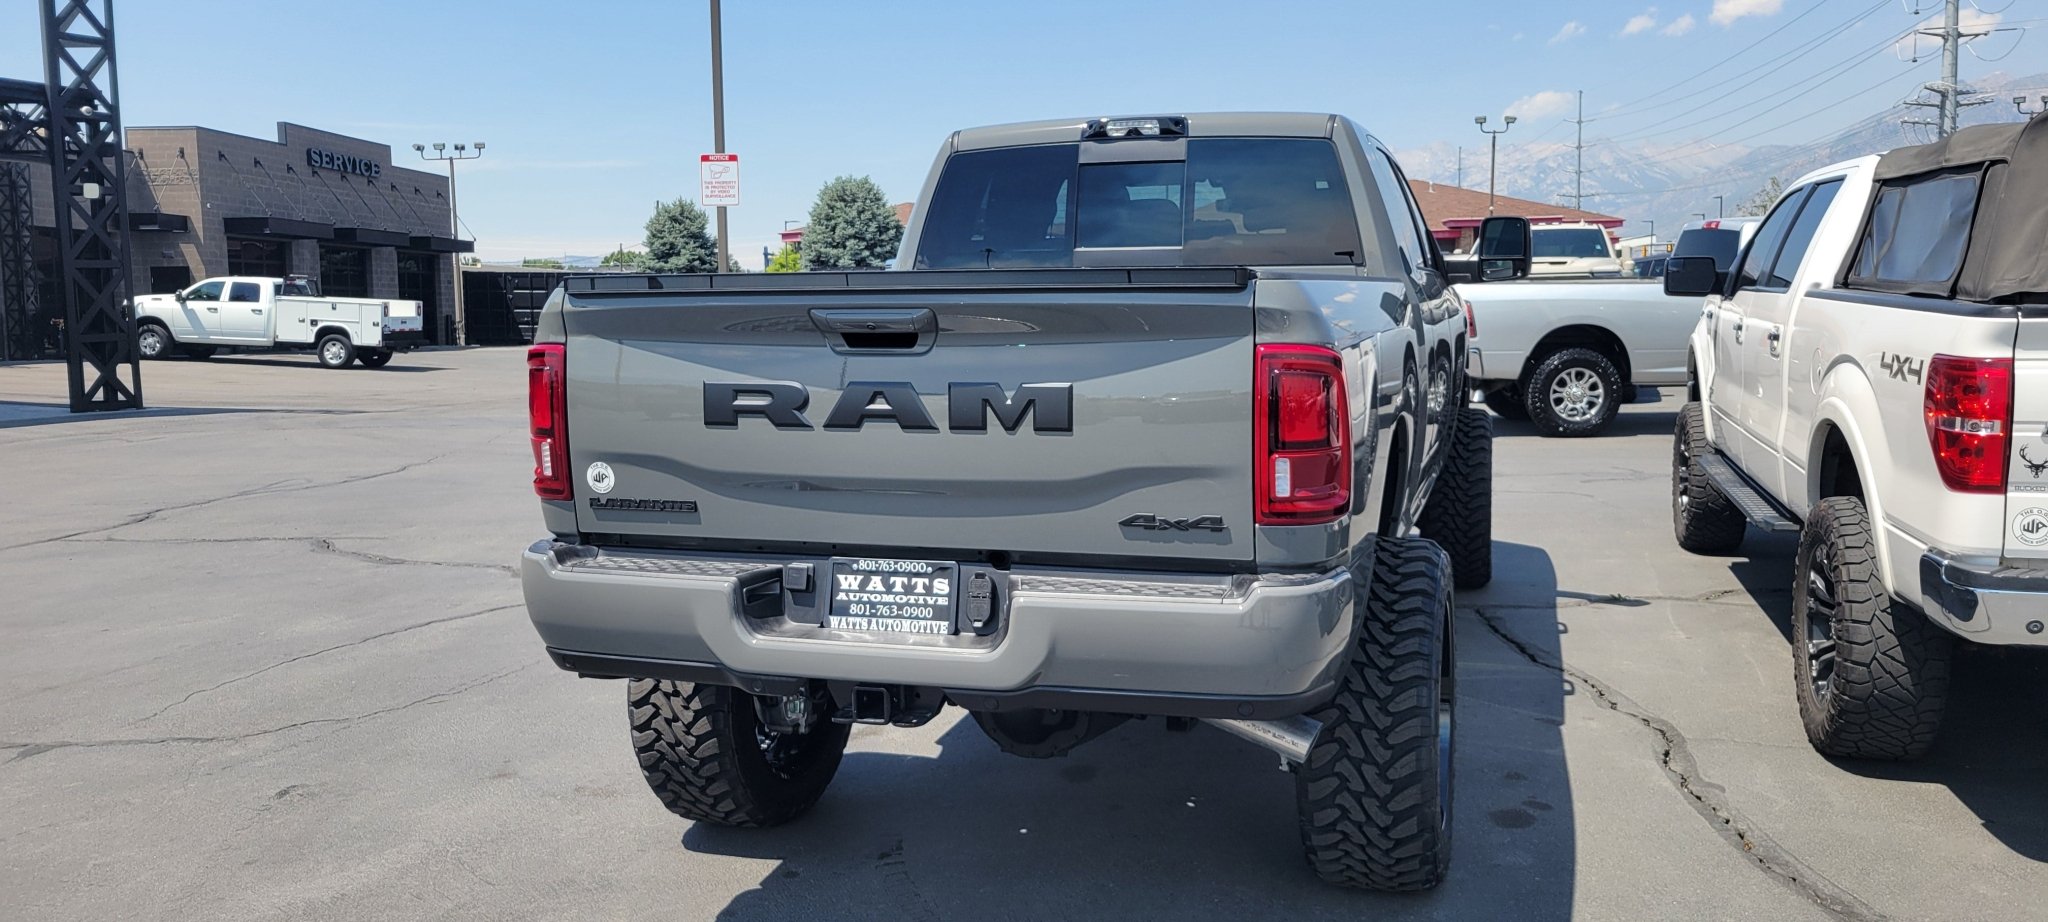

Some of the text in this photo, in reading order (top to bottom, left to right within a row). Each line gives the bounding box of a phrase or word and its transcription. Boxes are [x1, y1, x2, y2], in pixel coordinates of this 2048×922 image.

[307, 148, 381, 177] SERVICE
[703, 380, 1074, 434] RAM
[589, 497, 698, 512] LARAMIE
[2020, 509, 2034, 517] THE
[858, 559, 927, 573] 801-763-0900
[836, 574, 950, 595] WATTS
[835, 592, 949, 605] AUTOMOTIVE
[849, 603, 933, 618] 801-763-0900
[829, 616, 949, 634] WATTS AUTOMOTIVE
